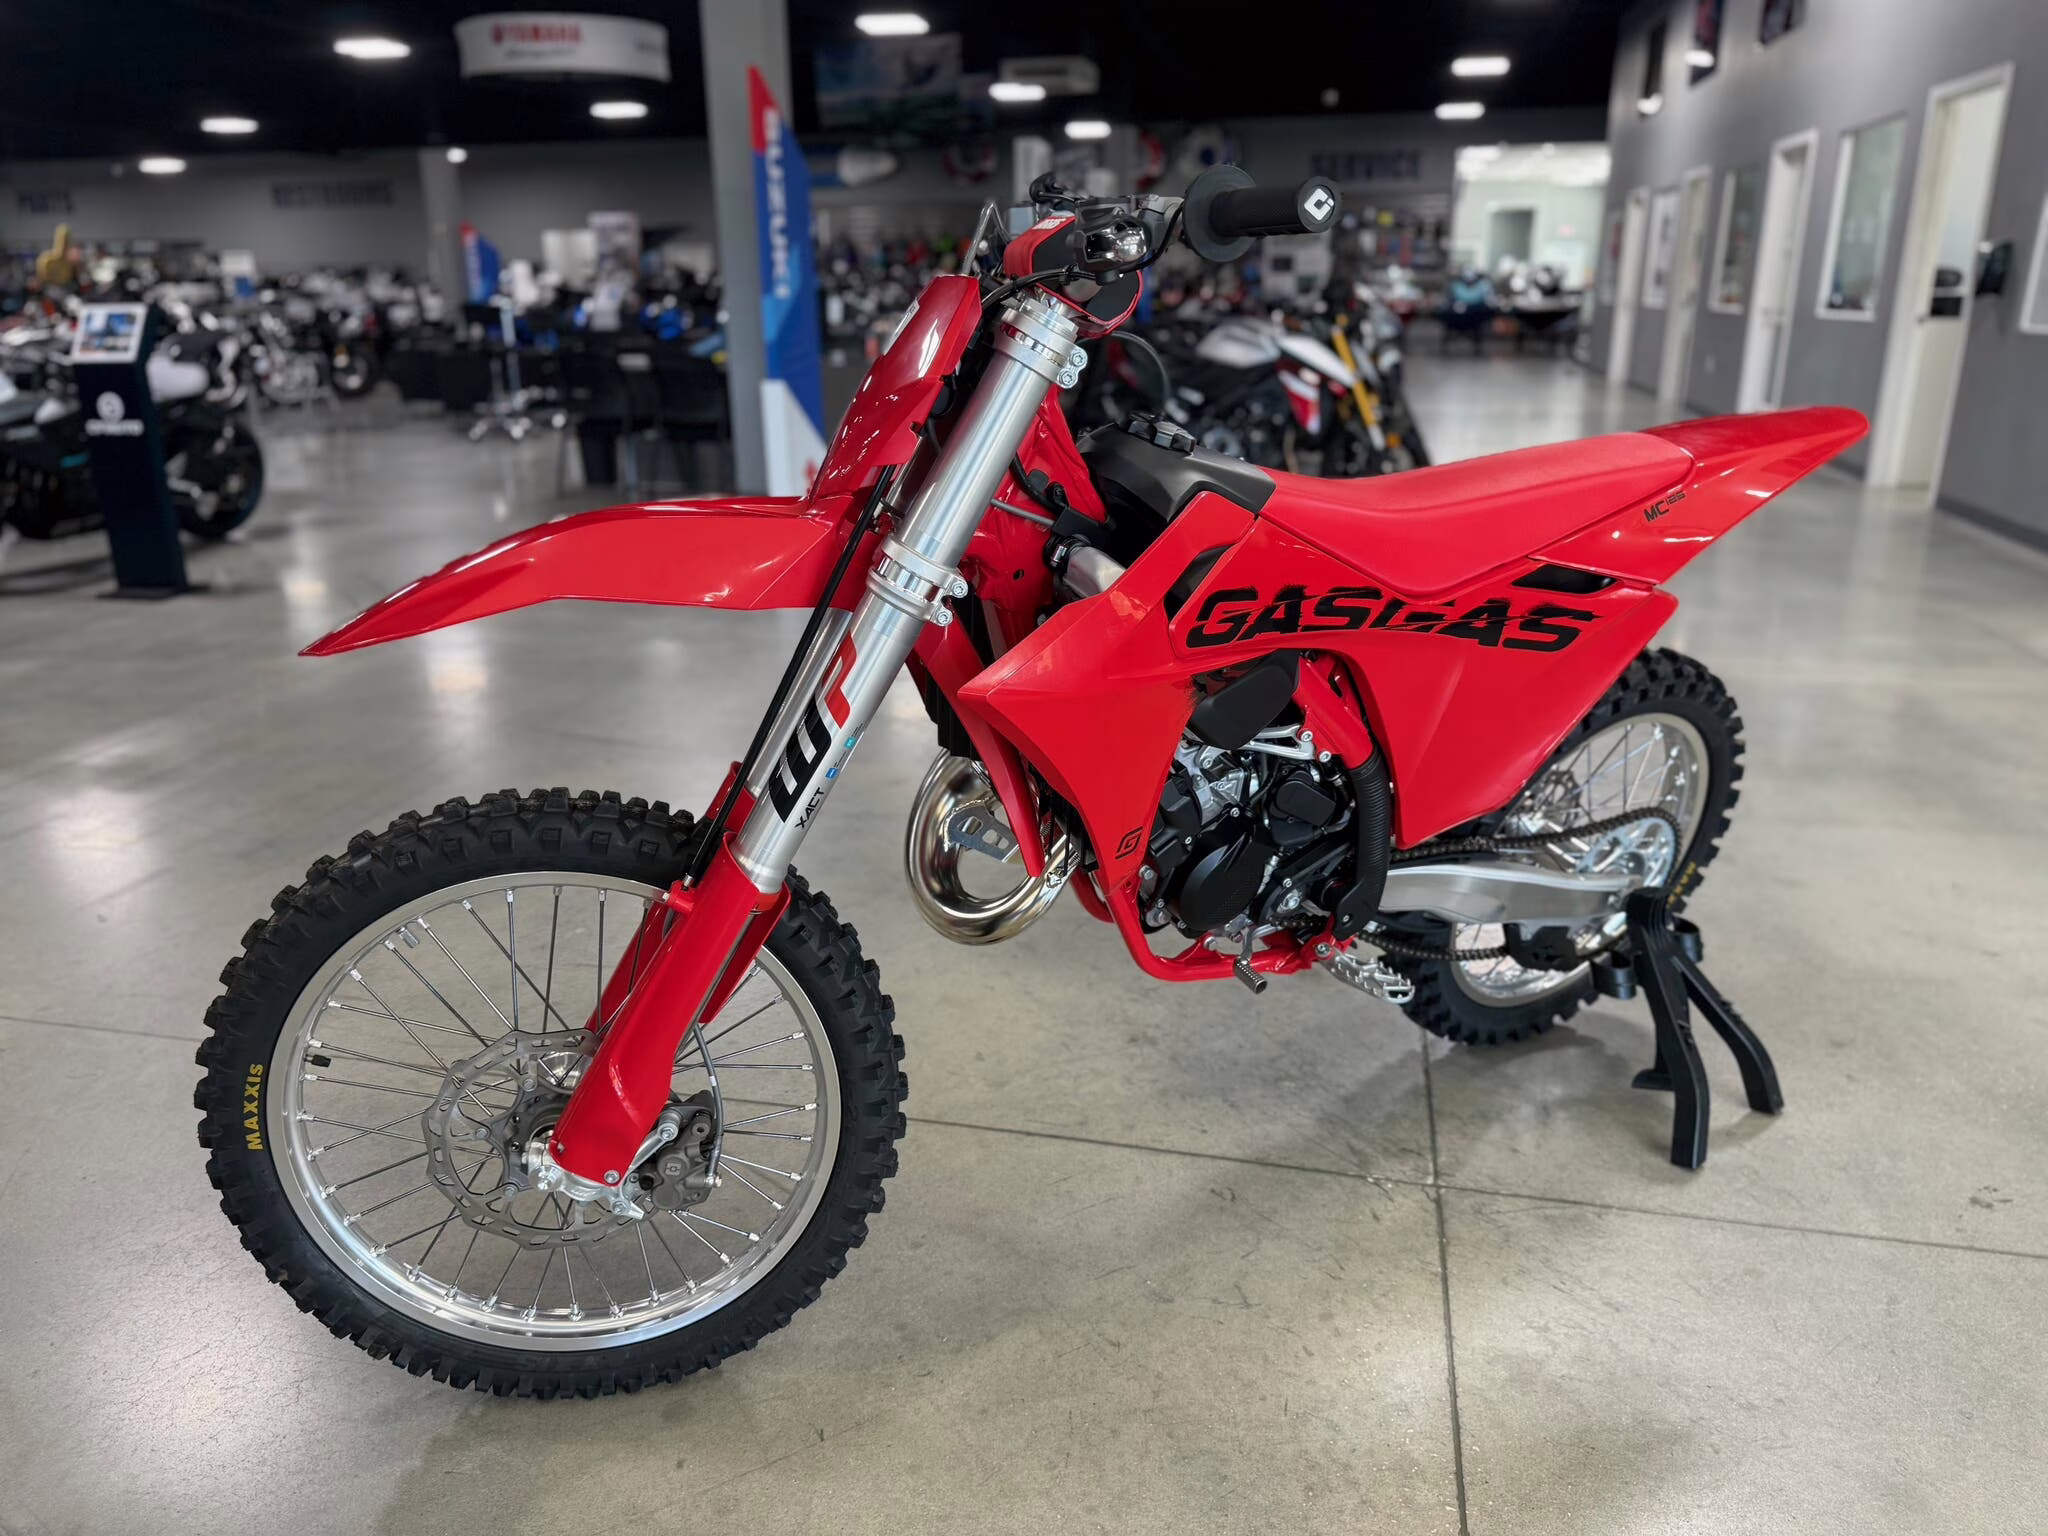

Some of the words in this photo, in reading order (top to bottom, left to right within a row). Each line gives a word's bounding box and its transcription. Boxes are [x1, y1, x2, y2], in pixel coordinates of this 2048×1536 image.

[1186, 584, 1603, 653] GASGAS
[795, 786, 825, 829] XACT
[243, 1063, 264, 1151] MAXXIS
